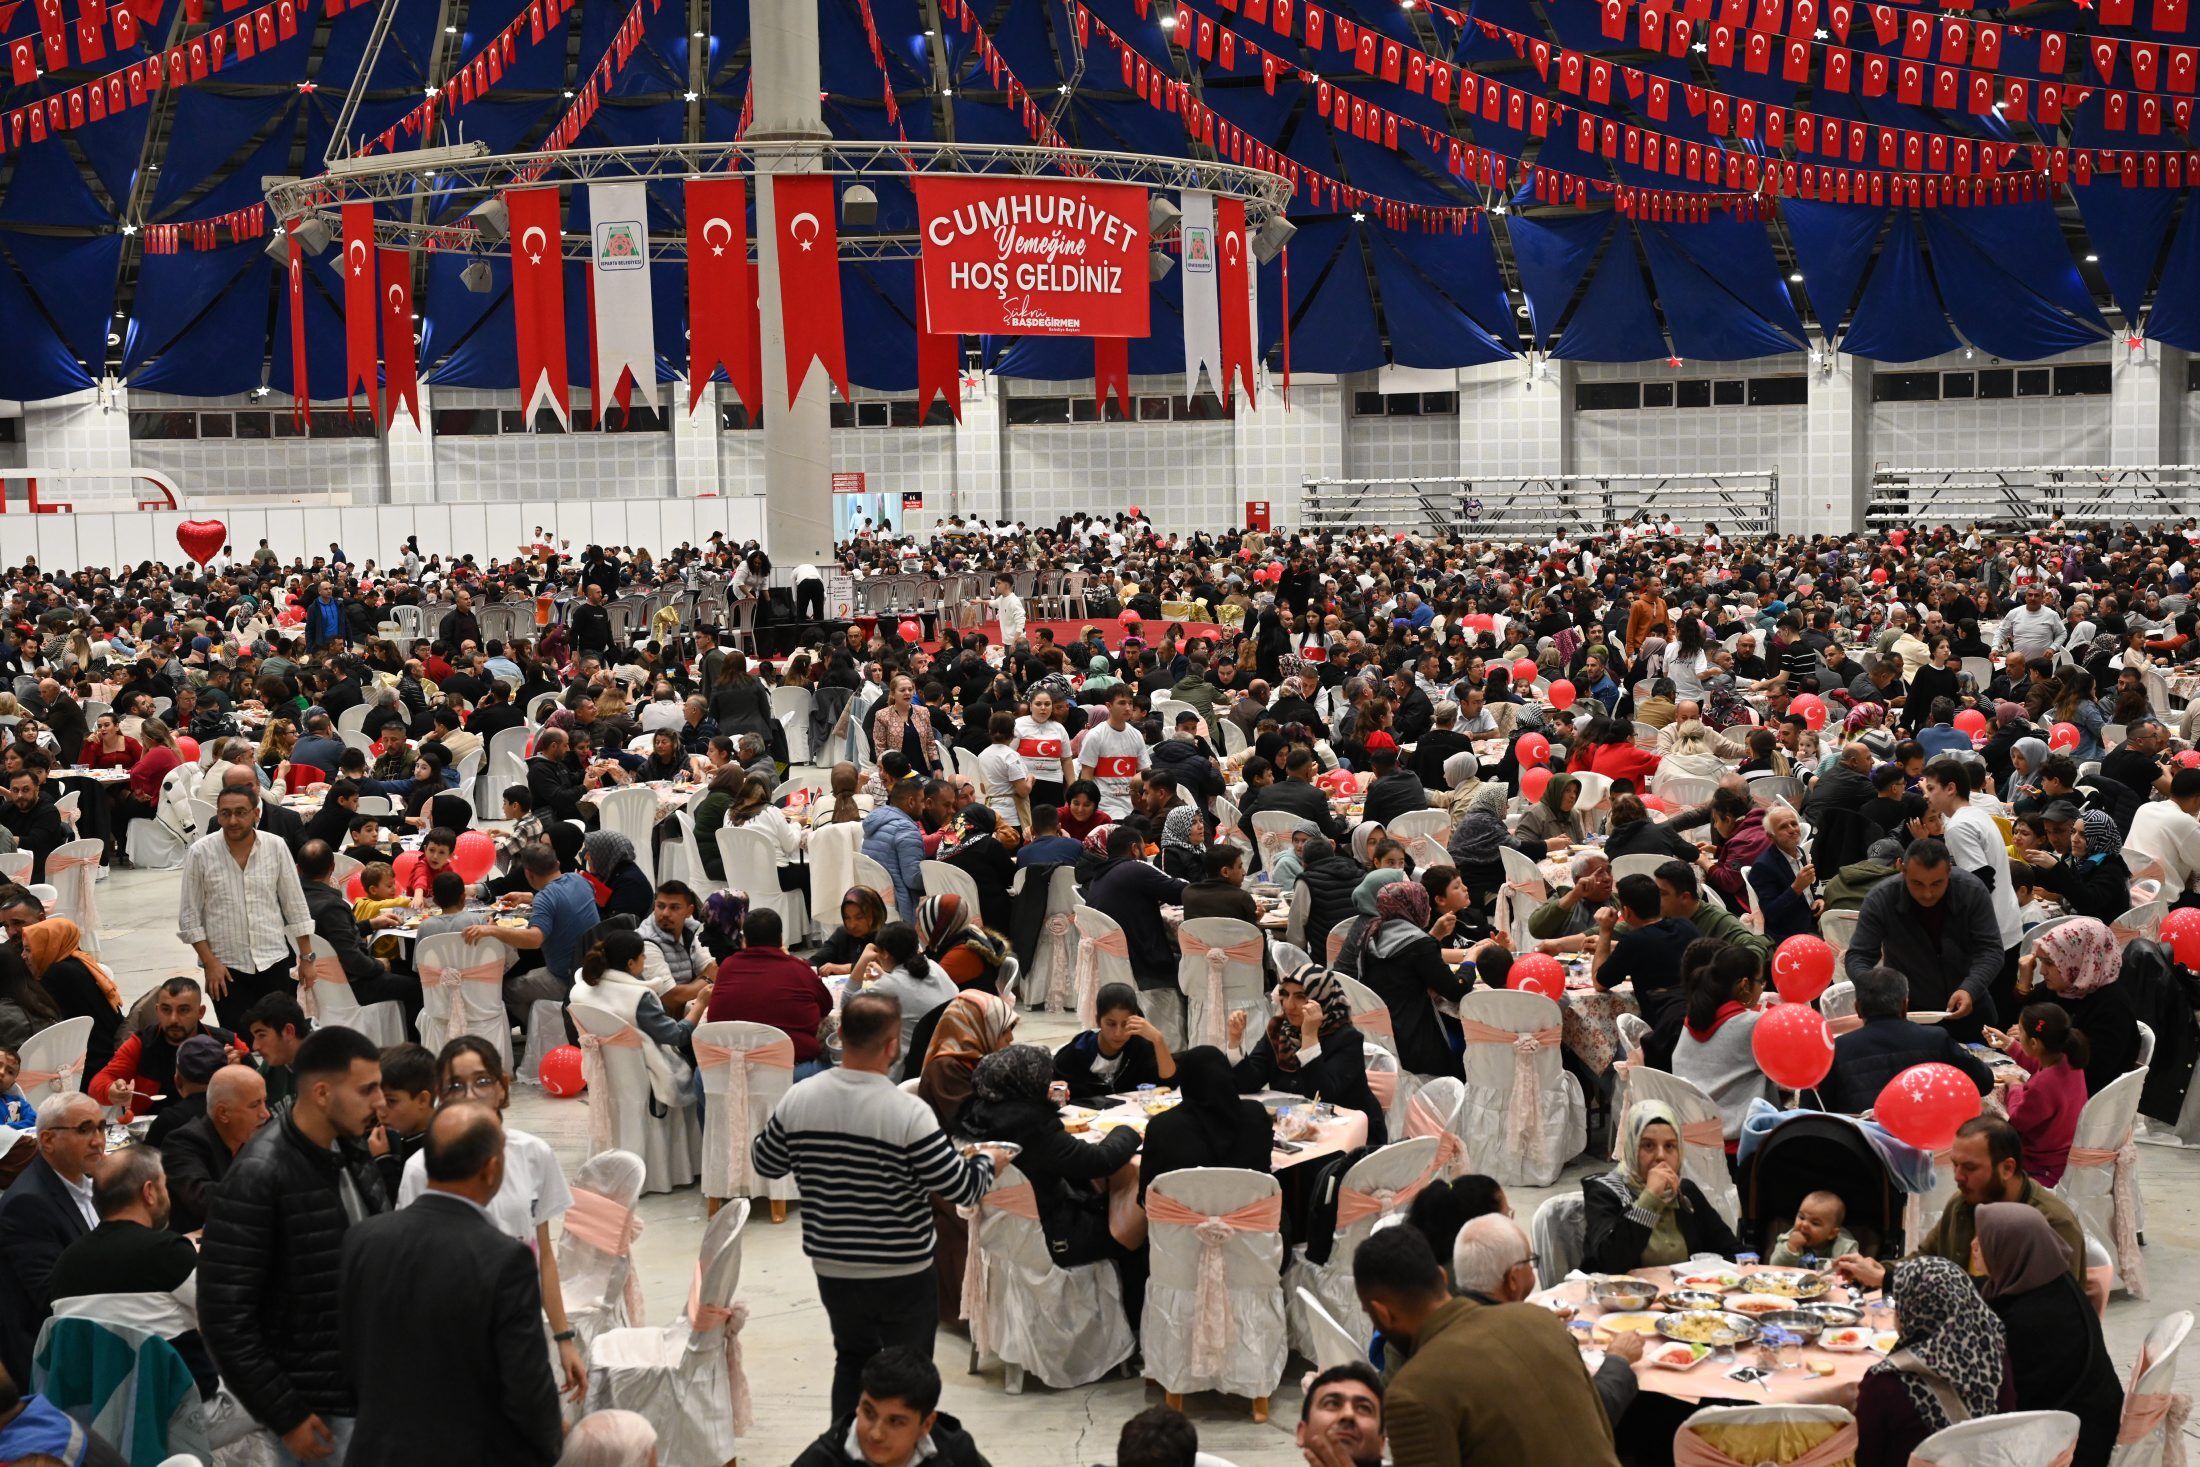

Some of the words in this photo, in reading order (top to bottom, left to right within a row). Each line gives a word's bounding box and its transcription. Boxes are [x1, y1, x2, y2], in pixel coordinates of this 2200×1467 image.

[928, 194, 1138, 253] CUMHURİYET
[993, 224, 1087, 264] Yemeğine
[951, 261, 1009, 300] HOŞ
[1016, 258, 1122, 294] GELDİNİZ
[1003, 294, 1047, 326] Şükrü
[1012, 316, 1080, 328] BAŞDEĞİRMEN
